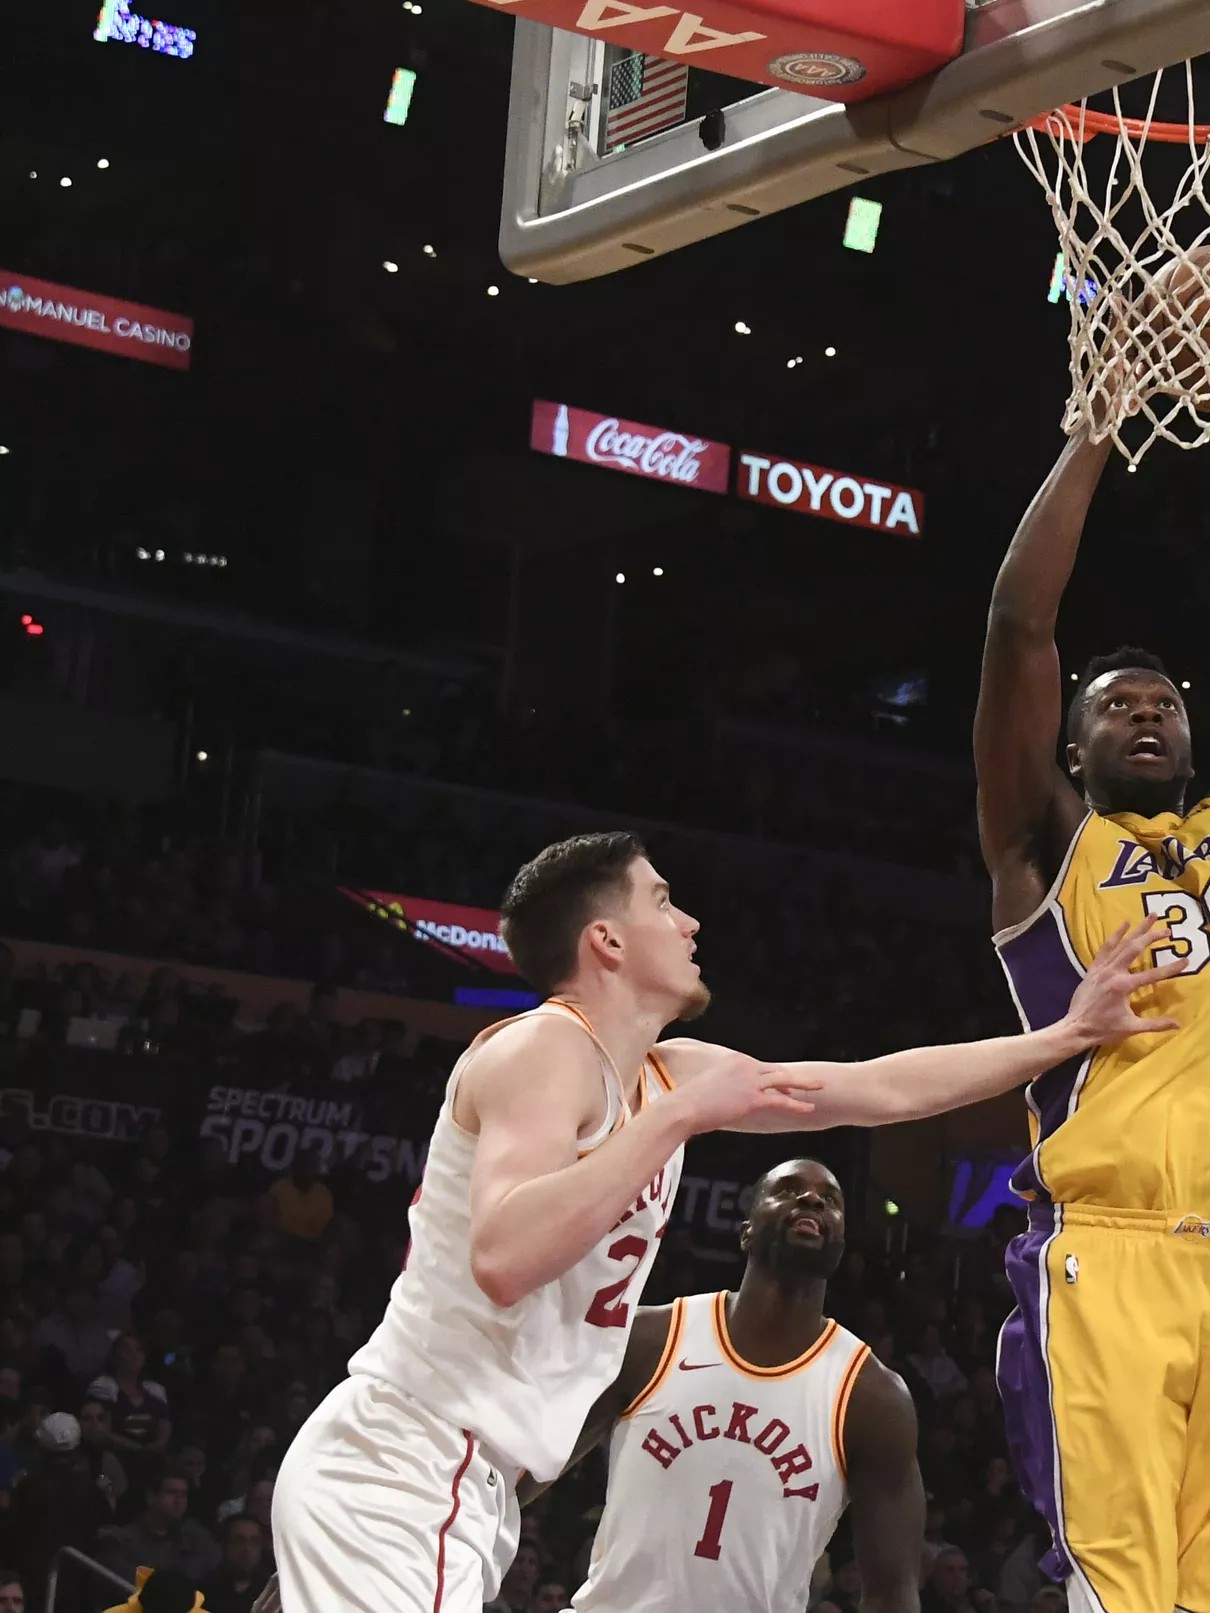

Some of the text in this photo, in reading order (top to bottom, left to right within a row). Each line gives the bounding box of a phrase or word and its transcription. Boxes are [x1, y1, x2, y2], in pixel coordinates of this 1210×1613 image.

[488, 0, 768, 54] AA
[26, 295, 111, 333] MANUEL
[113, 317, 191, 352] CASINO
[740, 454, 920, 535] TOYOTA
[206, 1084, 353, 1128] SPECTRUM
[584, 1218, 669, 1328] 2
[641, 1401, 820, 1501] HICKORY
[694, 1479, 734, 1561] 1
